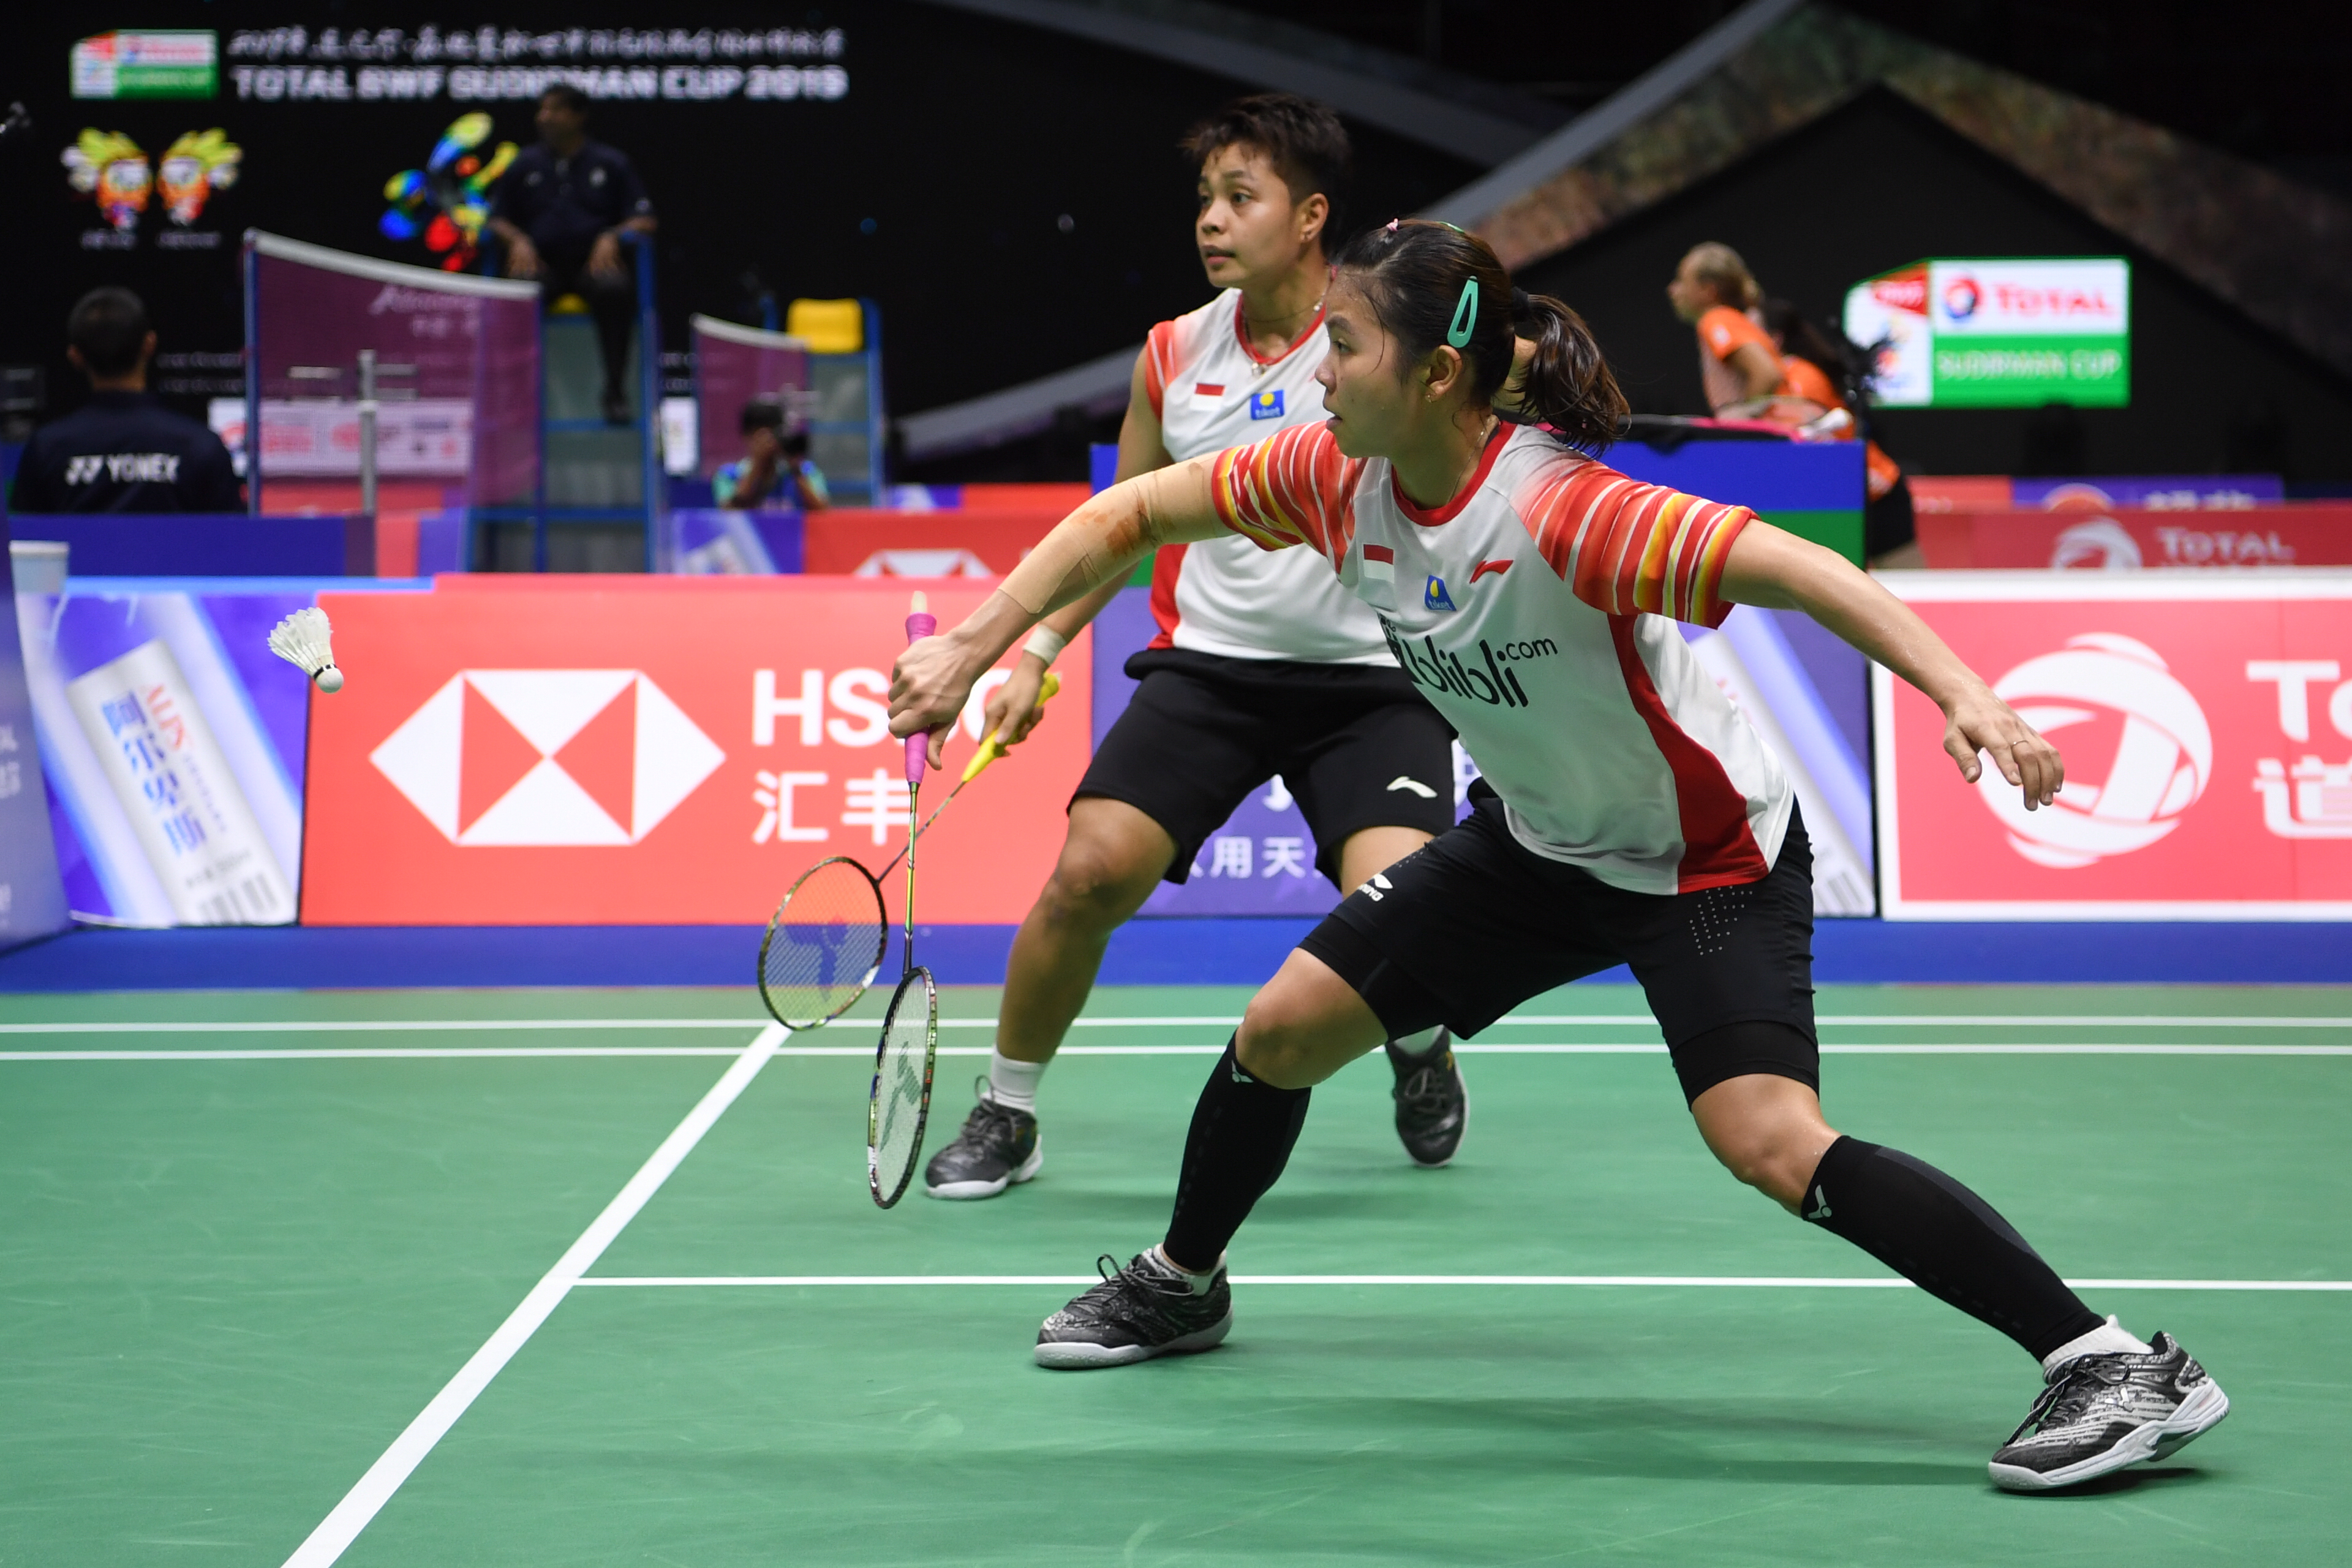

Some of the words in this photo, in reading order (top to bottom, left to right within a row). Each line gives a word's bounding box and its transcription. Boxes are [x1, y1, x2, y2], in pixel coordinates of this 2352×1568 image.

[229, 65, 354, 100] TOTAL
[662, 65, 745, 101] CUP
[1993, 282, 2119, 317] TOTAL
[107, 453, 180, 484] YONEX
[2157, 526, 2295, 560] TOTAL
[752, 767, 919, 846] 汇丰
